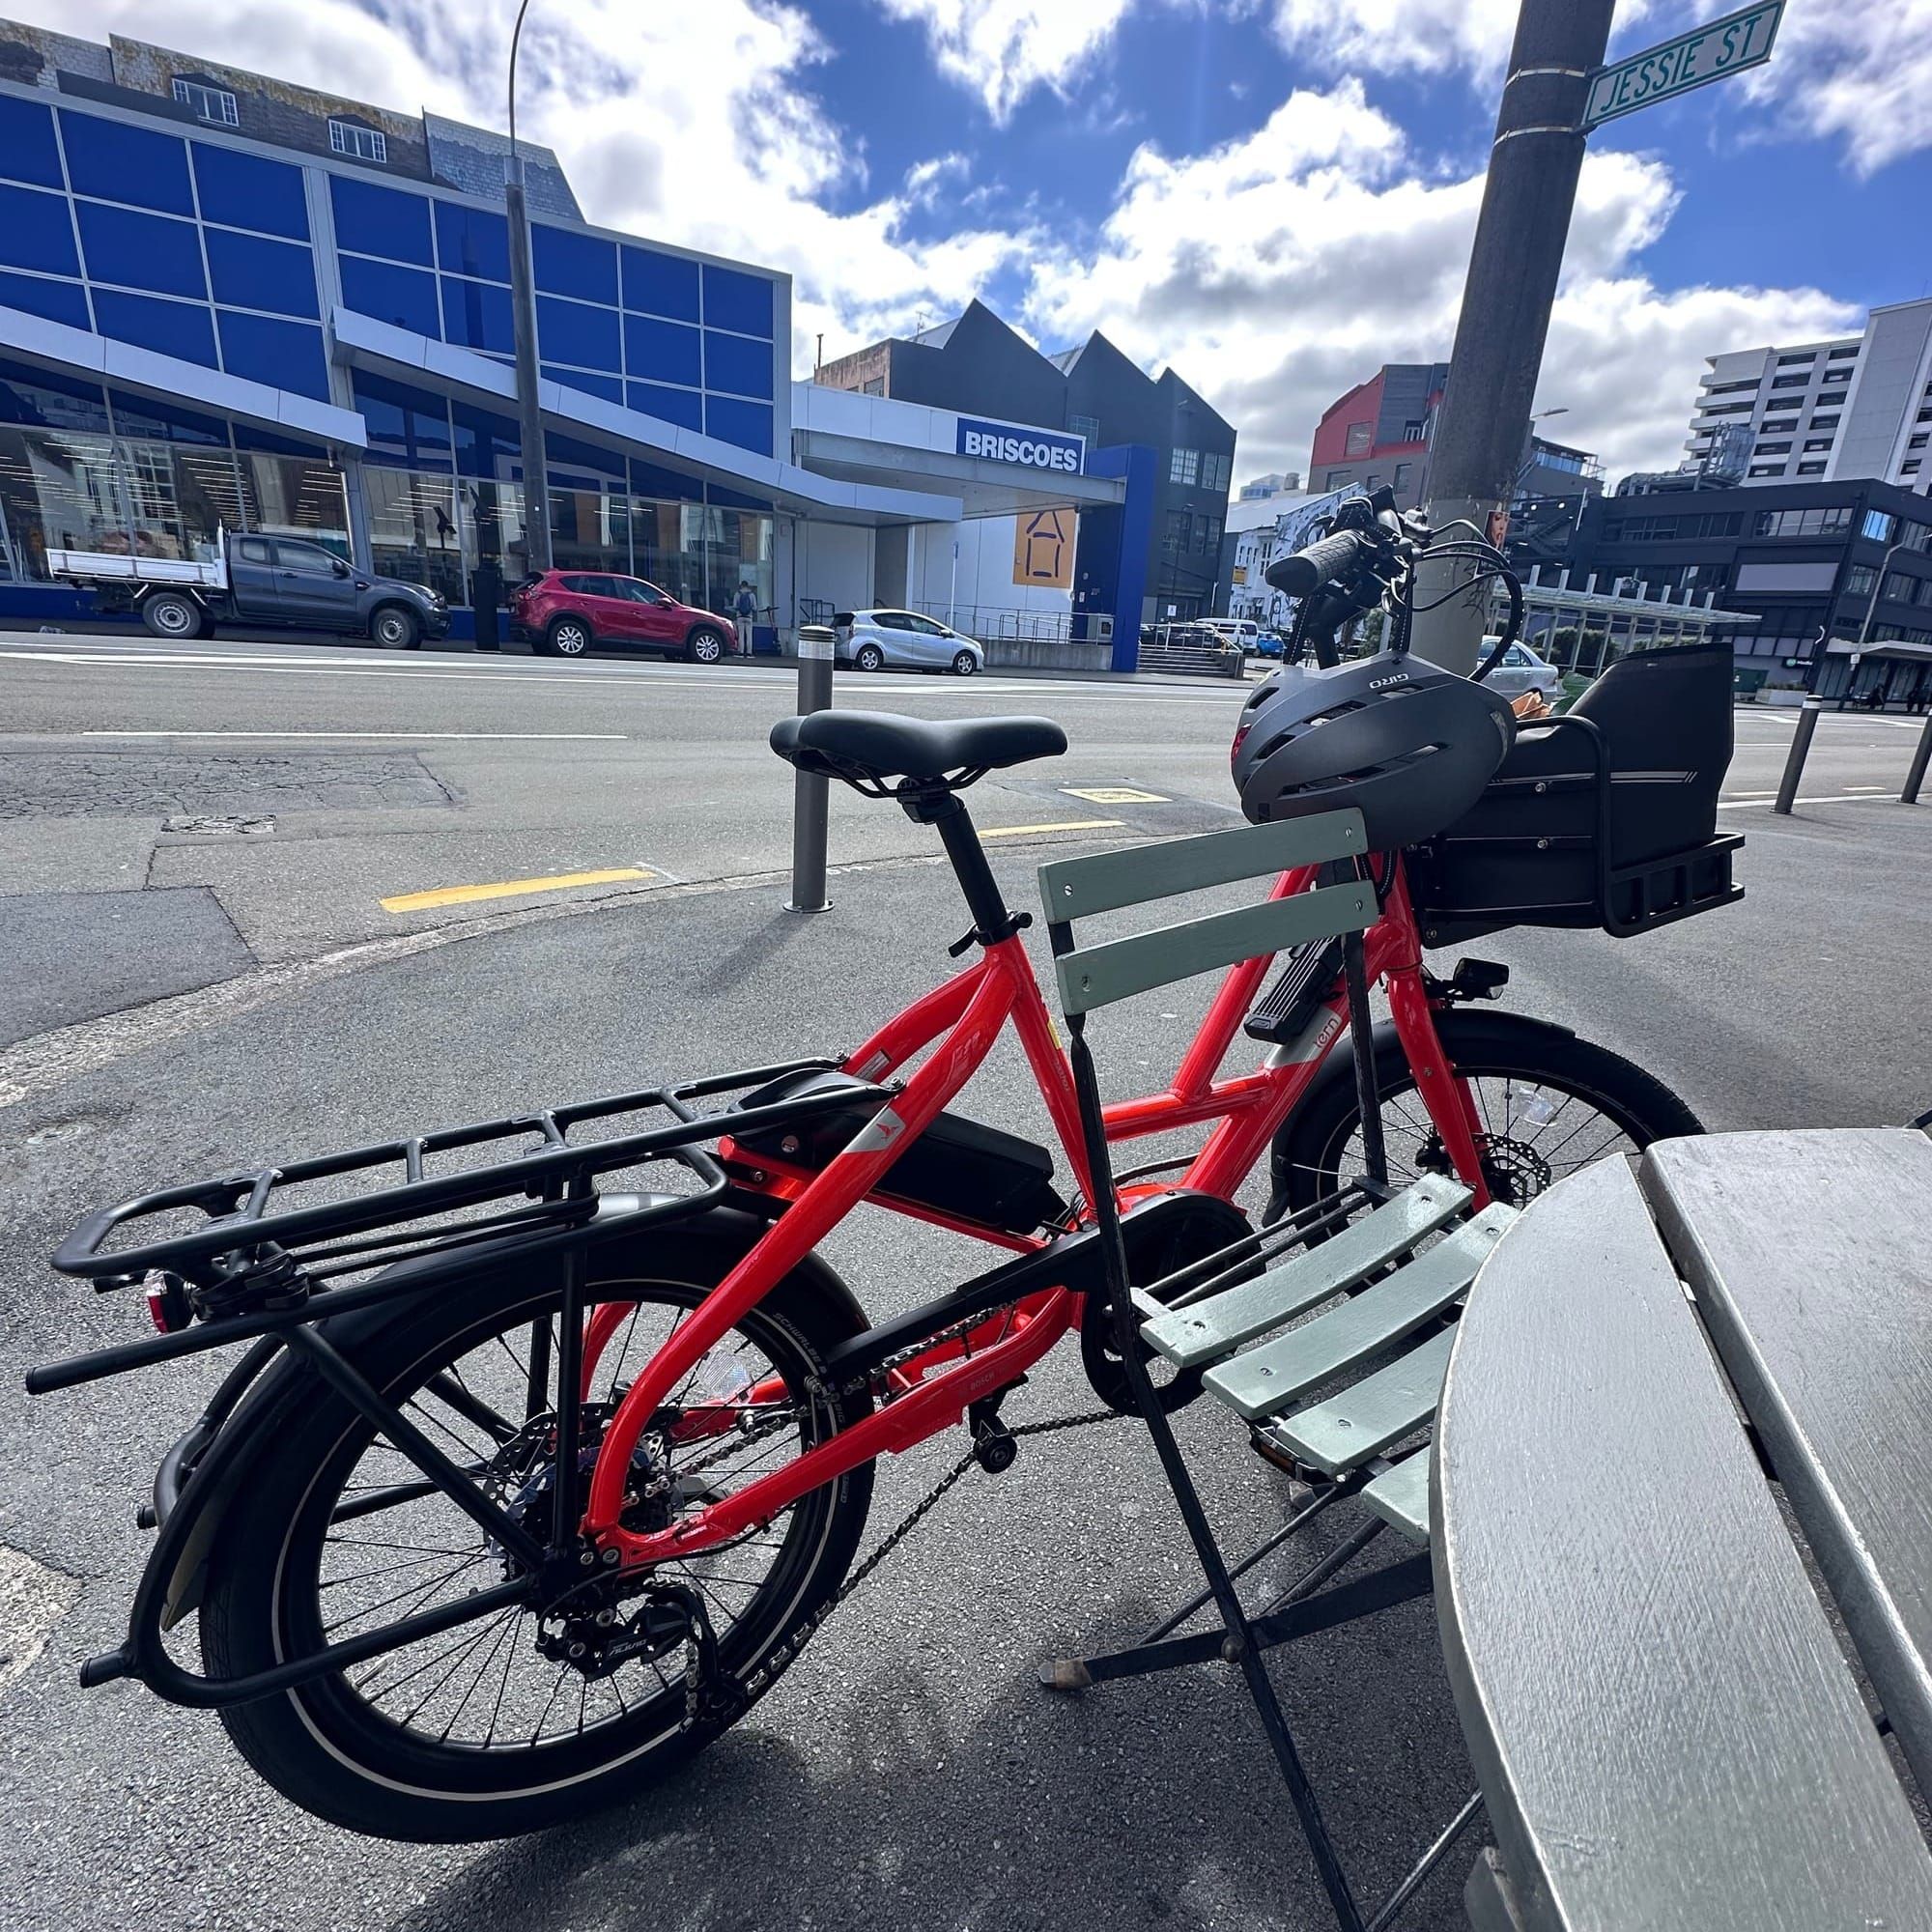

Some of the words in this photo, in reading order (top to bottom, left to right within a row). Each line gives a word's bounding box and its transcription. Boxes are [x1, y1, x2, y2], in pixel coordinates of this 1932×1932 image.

[1600, 39, 1705, 113] JESSIE
[1716, 15, 1762, 67] ST
[965, 430, 1078, 471] BRISCOES
[1369, 673, 1409, 689] GIRO
[1313, 1018, 1339, 1048] tern
